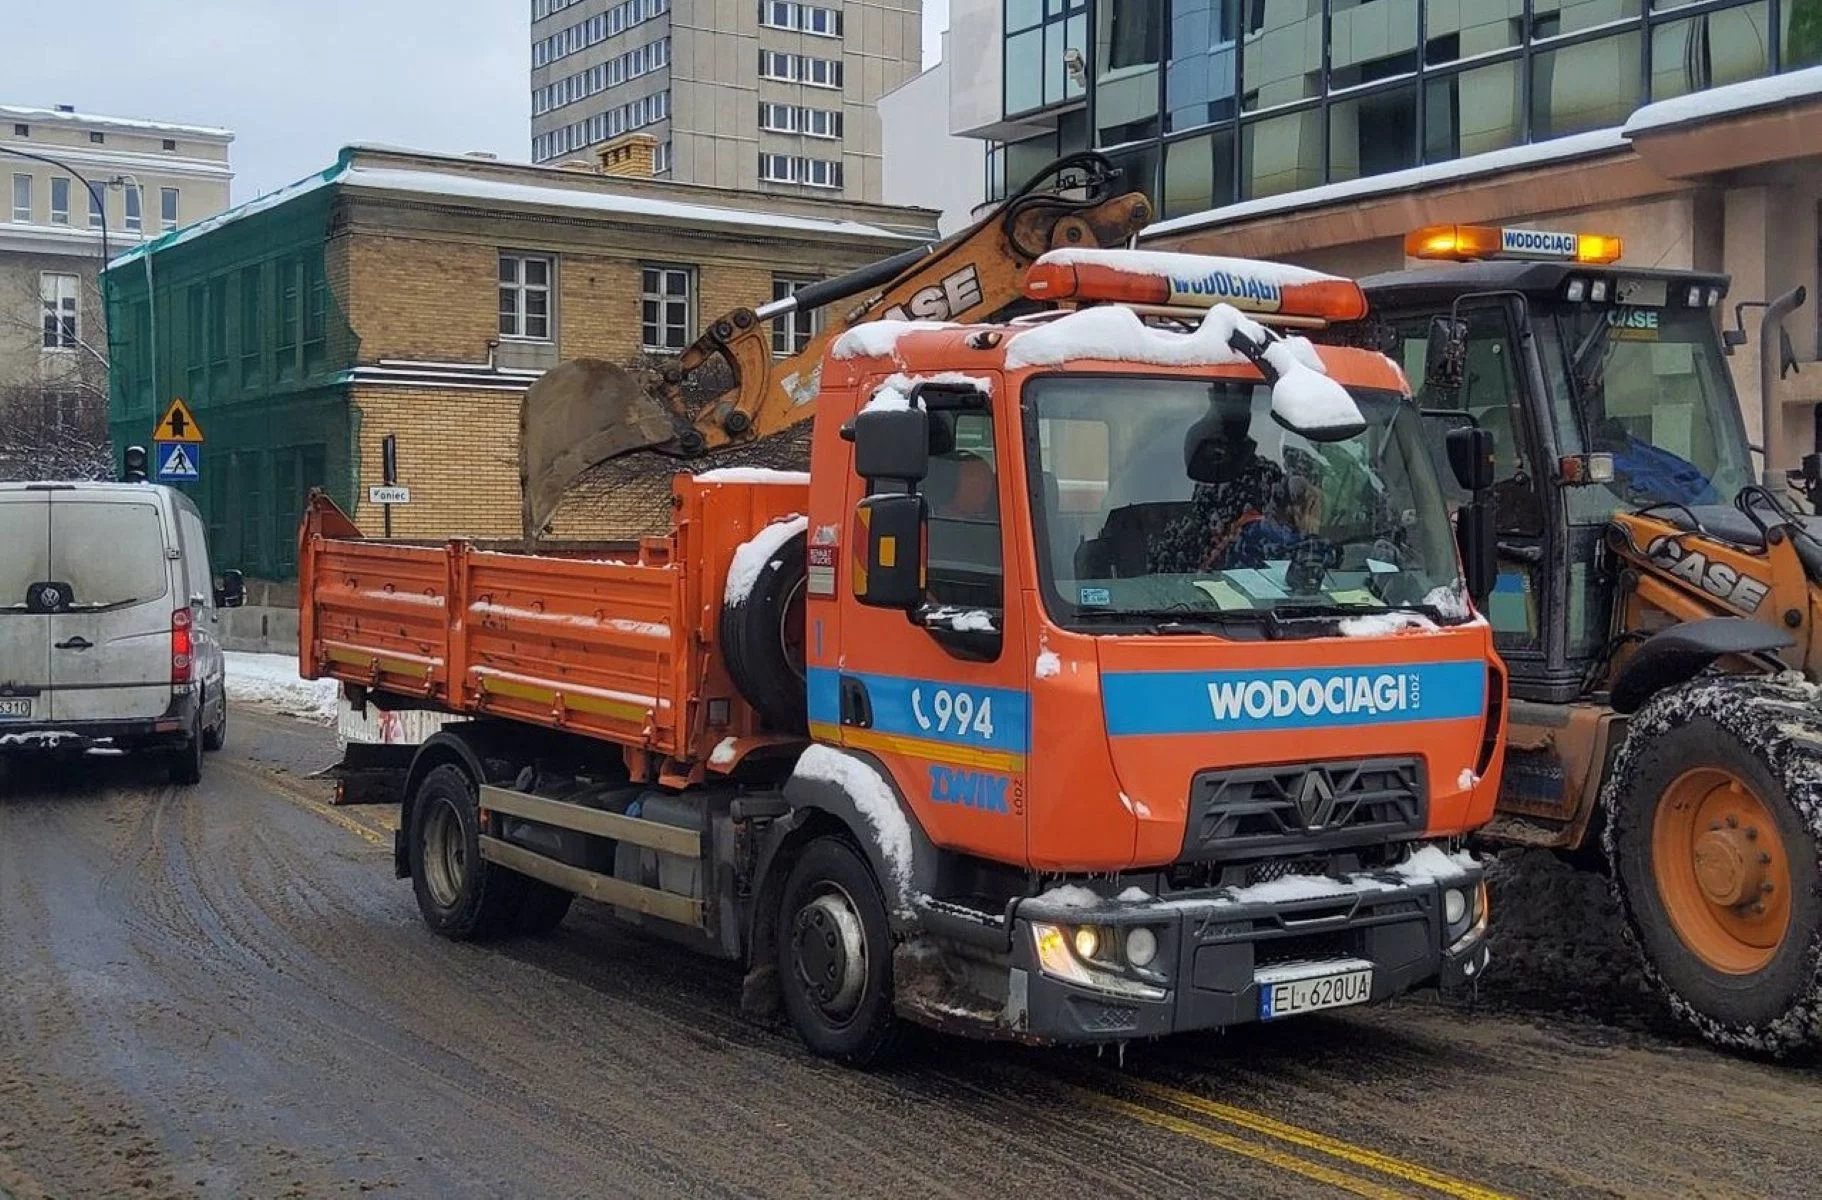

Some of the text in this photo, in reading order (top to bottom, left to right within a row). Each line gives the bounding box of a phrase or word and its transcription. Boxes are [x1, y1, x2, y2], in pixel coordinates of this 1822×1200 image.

[1505, 232, 1576, 254] WODOCIĄGI
[881, 263, 983, 322] ASE
[1648, 535, 1770, 614] CASE
[934, 689, 994, 739] 994
[1207, 674, 1407, 720] WODOCIĄGI
[1275, 985, 1302, 1013] EL
[1310, 974, 1368, 1007] 620UA
